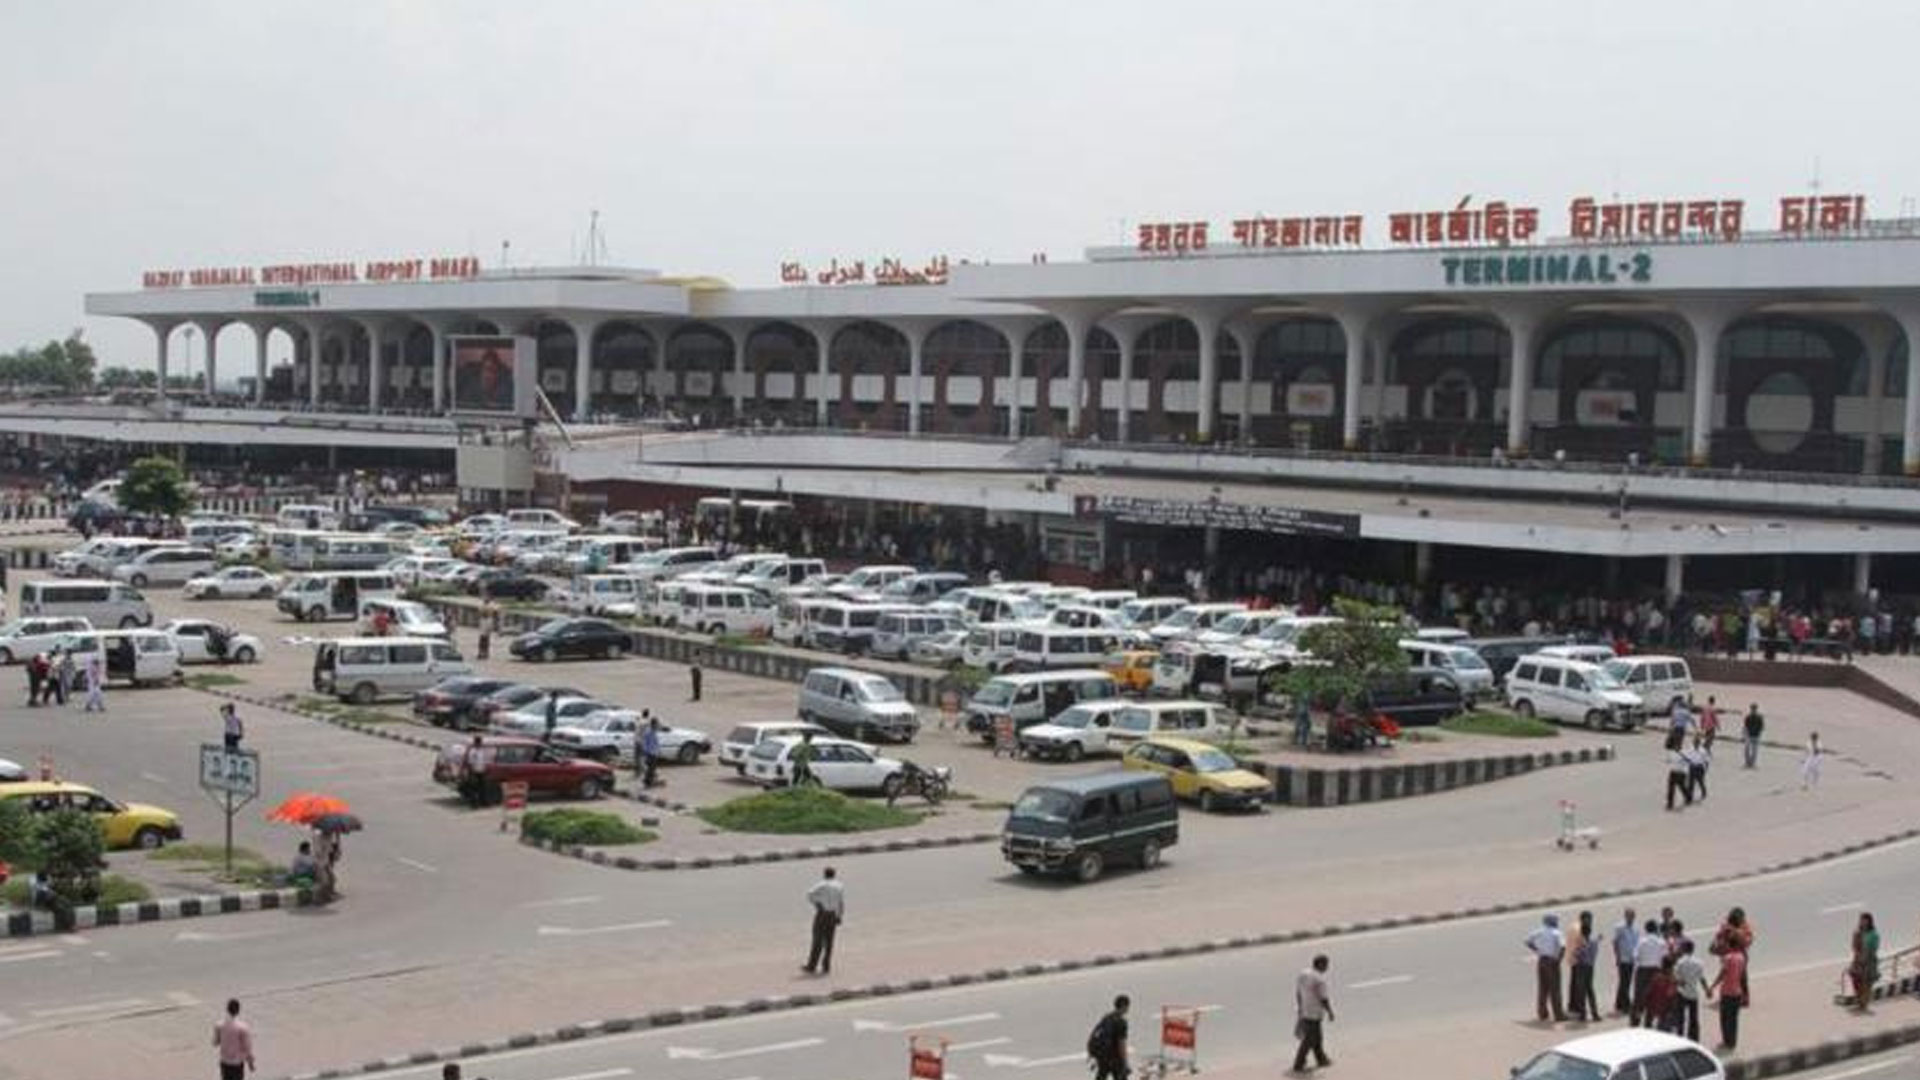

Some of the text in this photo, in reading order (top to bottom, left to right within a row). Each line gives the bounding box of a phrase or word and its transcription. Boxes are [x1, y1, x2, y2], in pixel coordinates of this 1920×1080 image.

[1781, 196, 1864, 231] ঢাকা
[366, 260, 422, 280] AIRPORT
[431, 258, 478, 278] DHAKA
[1441, 254, 1652, 284] TERMINAL-2
